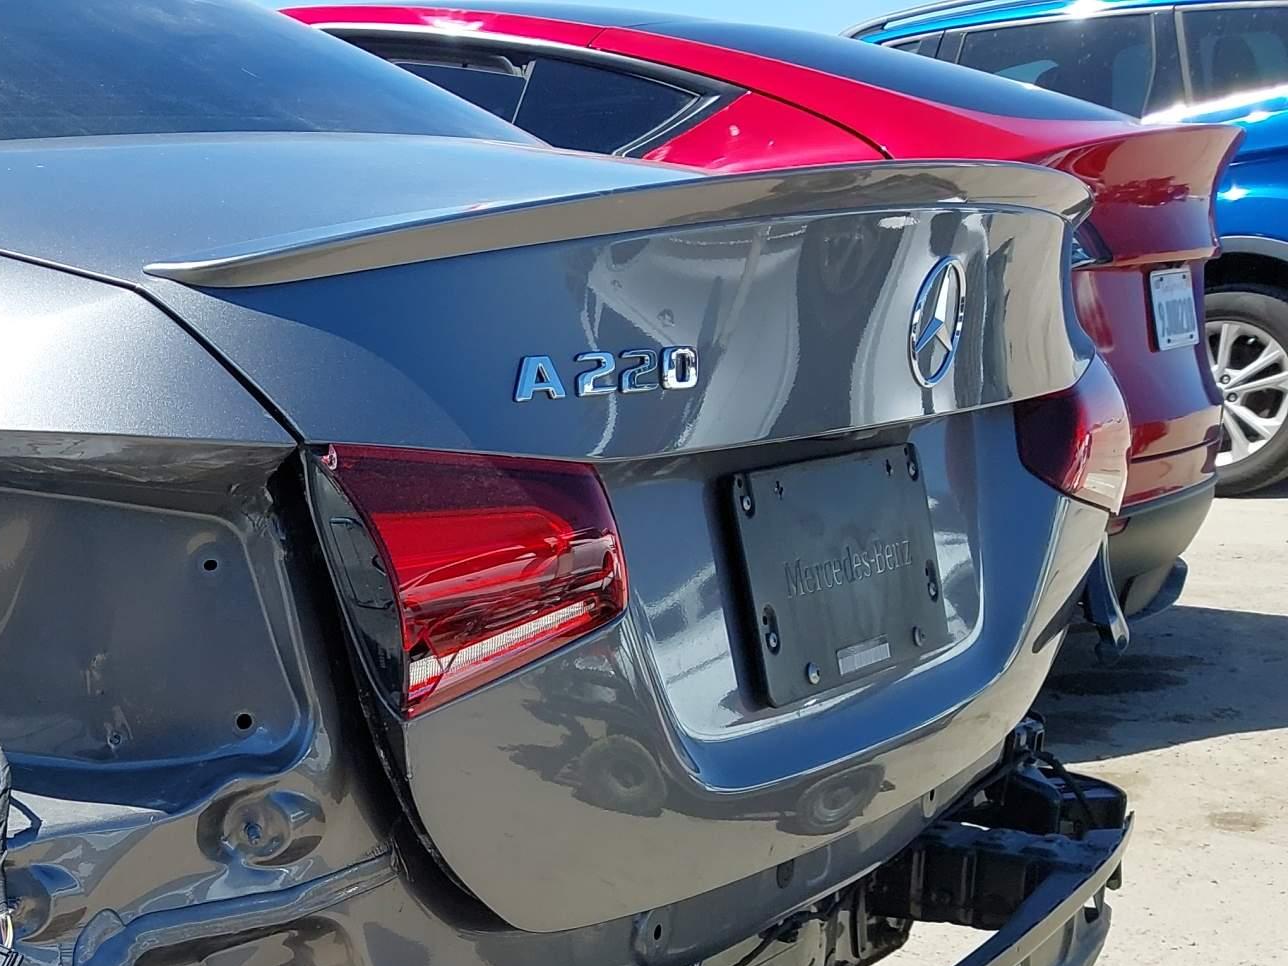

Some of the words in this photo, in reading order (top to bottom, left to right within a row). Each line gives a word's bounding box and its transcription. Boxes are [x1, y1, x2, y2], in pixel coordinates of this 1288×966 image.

[513, 355, 566, 402] A
[574, 346, 699, 397] 220
[783, 538, 912, 598] Mercedes-Benz
